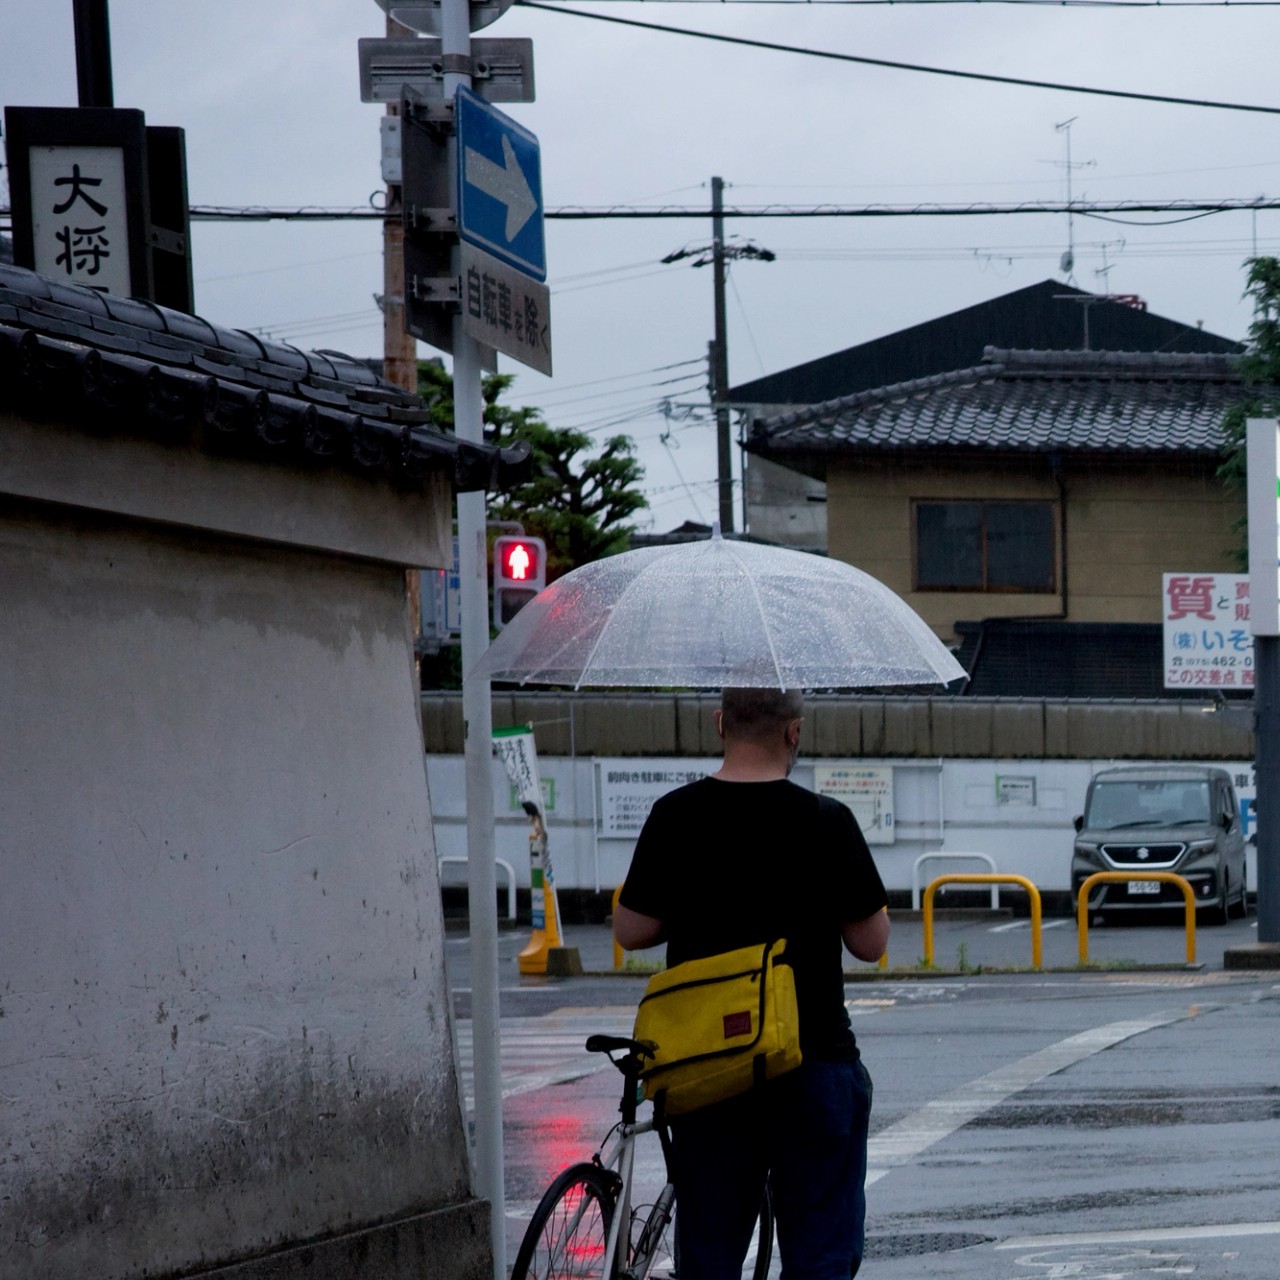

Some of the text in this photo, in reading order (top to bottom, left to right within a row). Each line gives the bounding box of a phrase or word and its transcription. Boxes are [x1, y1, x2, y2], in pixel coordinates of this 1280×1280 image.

[53, 164, 110, 292] 大将
[467, 265, 549, 355] 自転車を除く
[1167, 670, 1236, 685] この交差点
